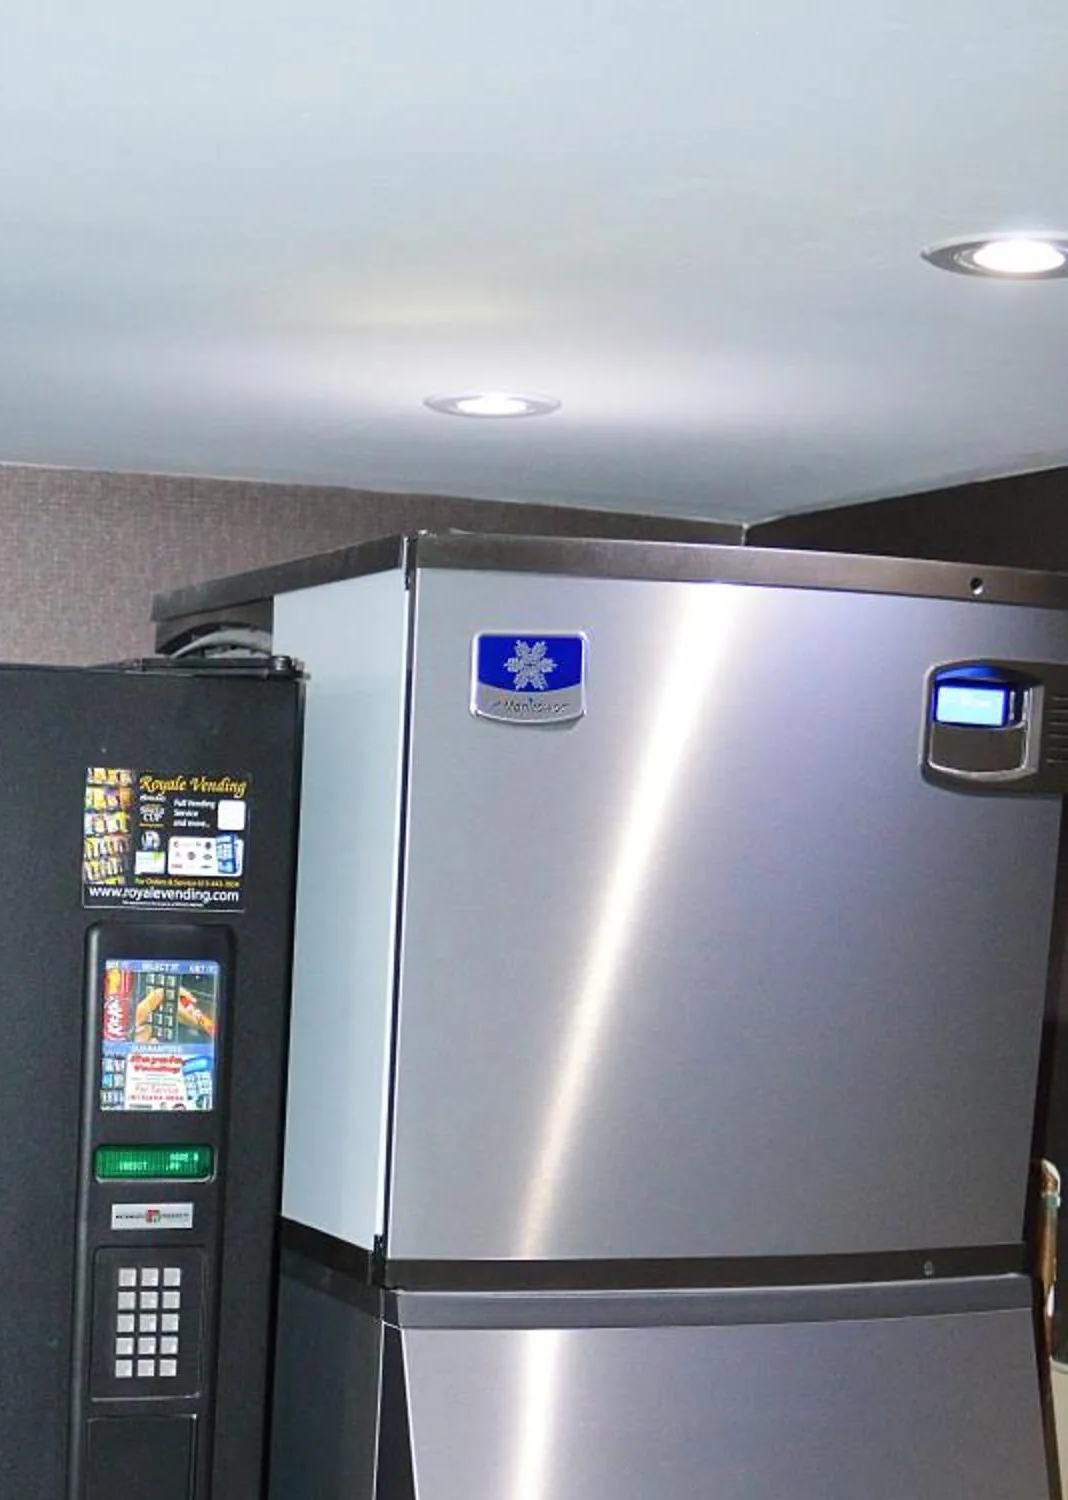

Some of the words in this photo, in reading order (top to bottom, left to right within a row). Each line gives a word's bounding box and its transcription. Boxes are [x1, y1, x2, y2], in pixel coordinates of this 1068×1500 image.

[139, 775, 186, 795] Royale
[190, 776, 247, 798] Vending
[88, 886, 240, 903] www.royalevending.com
